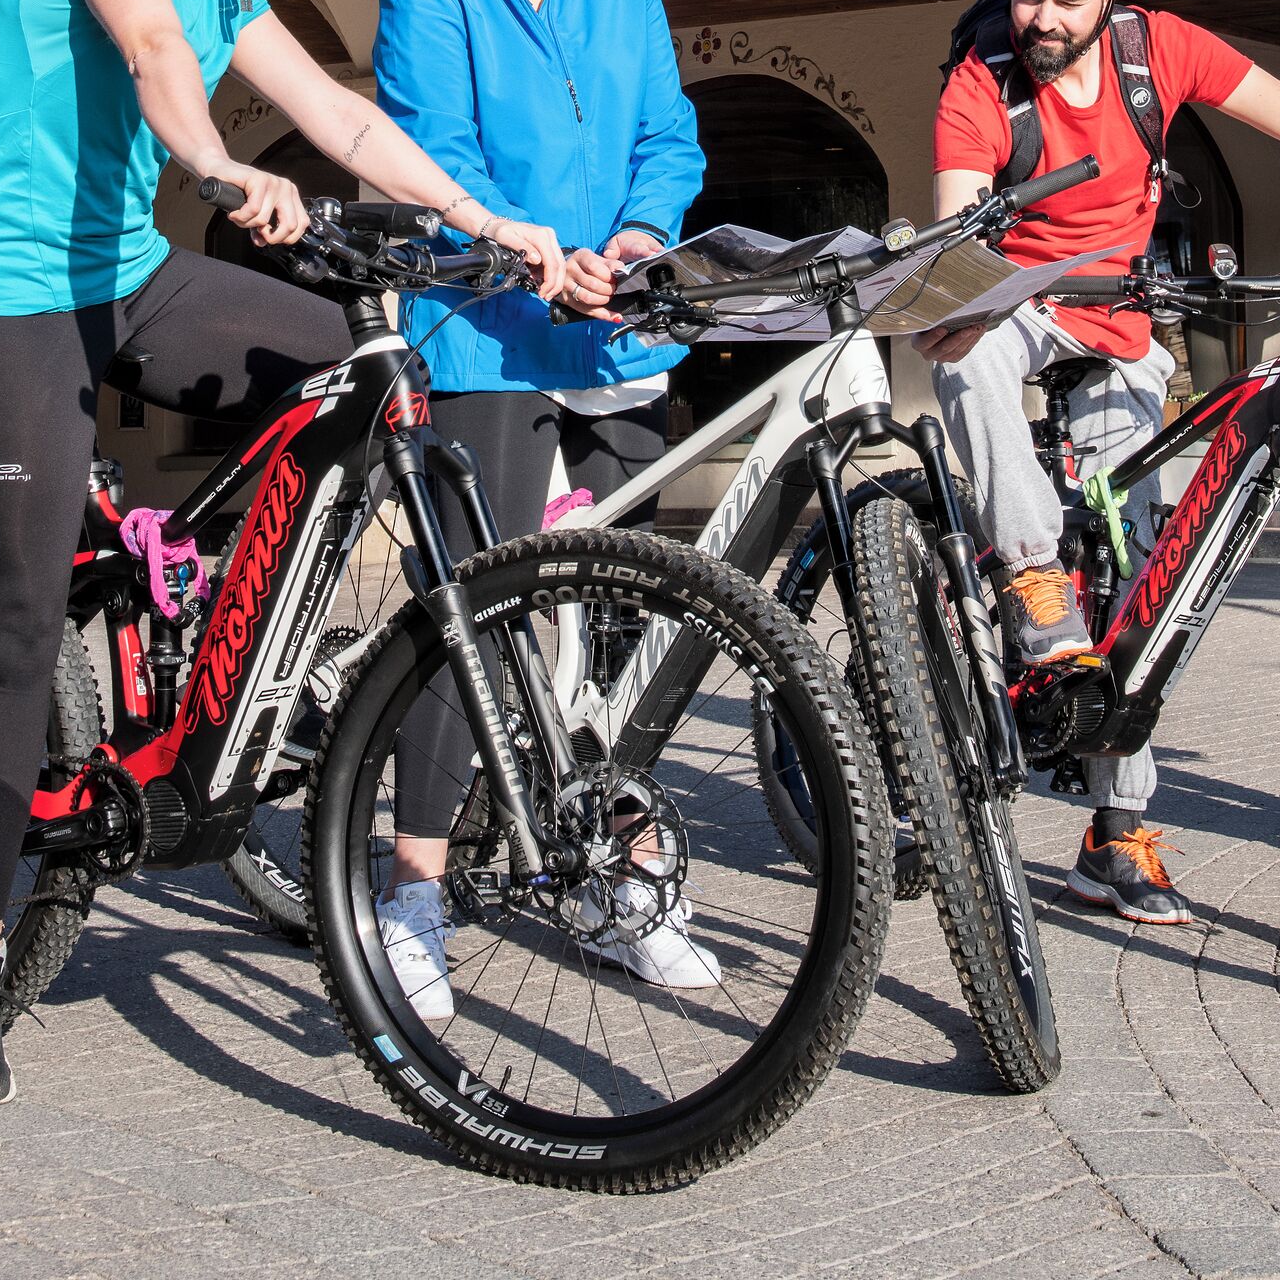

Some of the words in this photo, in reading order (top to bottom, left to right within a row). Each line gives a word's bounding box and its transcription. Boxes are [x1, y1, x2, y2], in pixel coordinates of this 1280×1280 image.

[215, 464, 241, 492] QUALITY
[591, 563, 662, 589] RON
[1194, 510, 1254, 610] LIGHTRIDER
[279, 544, 333, 679] LIGHTRIDER
[474, 595, 522, 622] HYBRID
[672, 588, 787, 683] ROCKET
[683, 612, 743, 661] SWISS
[749, 664, 776, 696] DT
[462, 643, 523, 796] manitou
[398, 1065, 608, 1160] SCHWALBE
